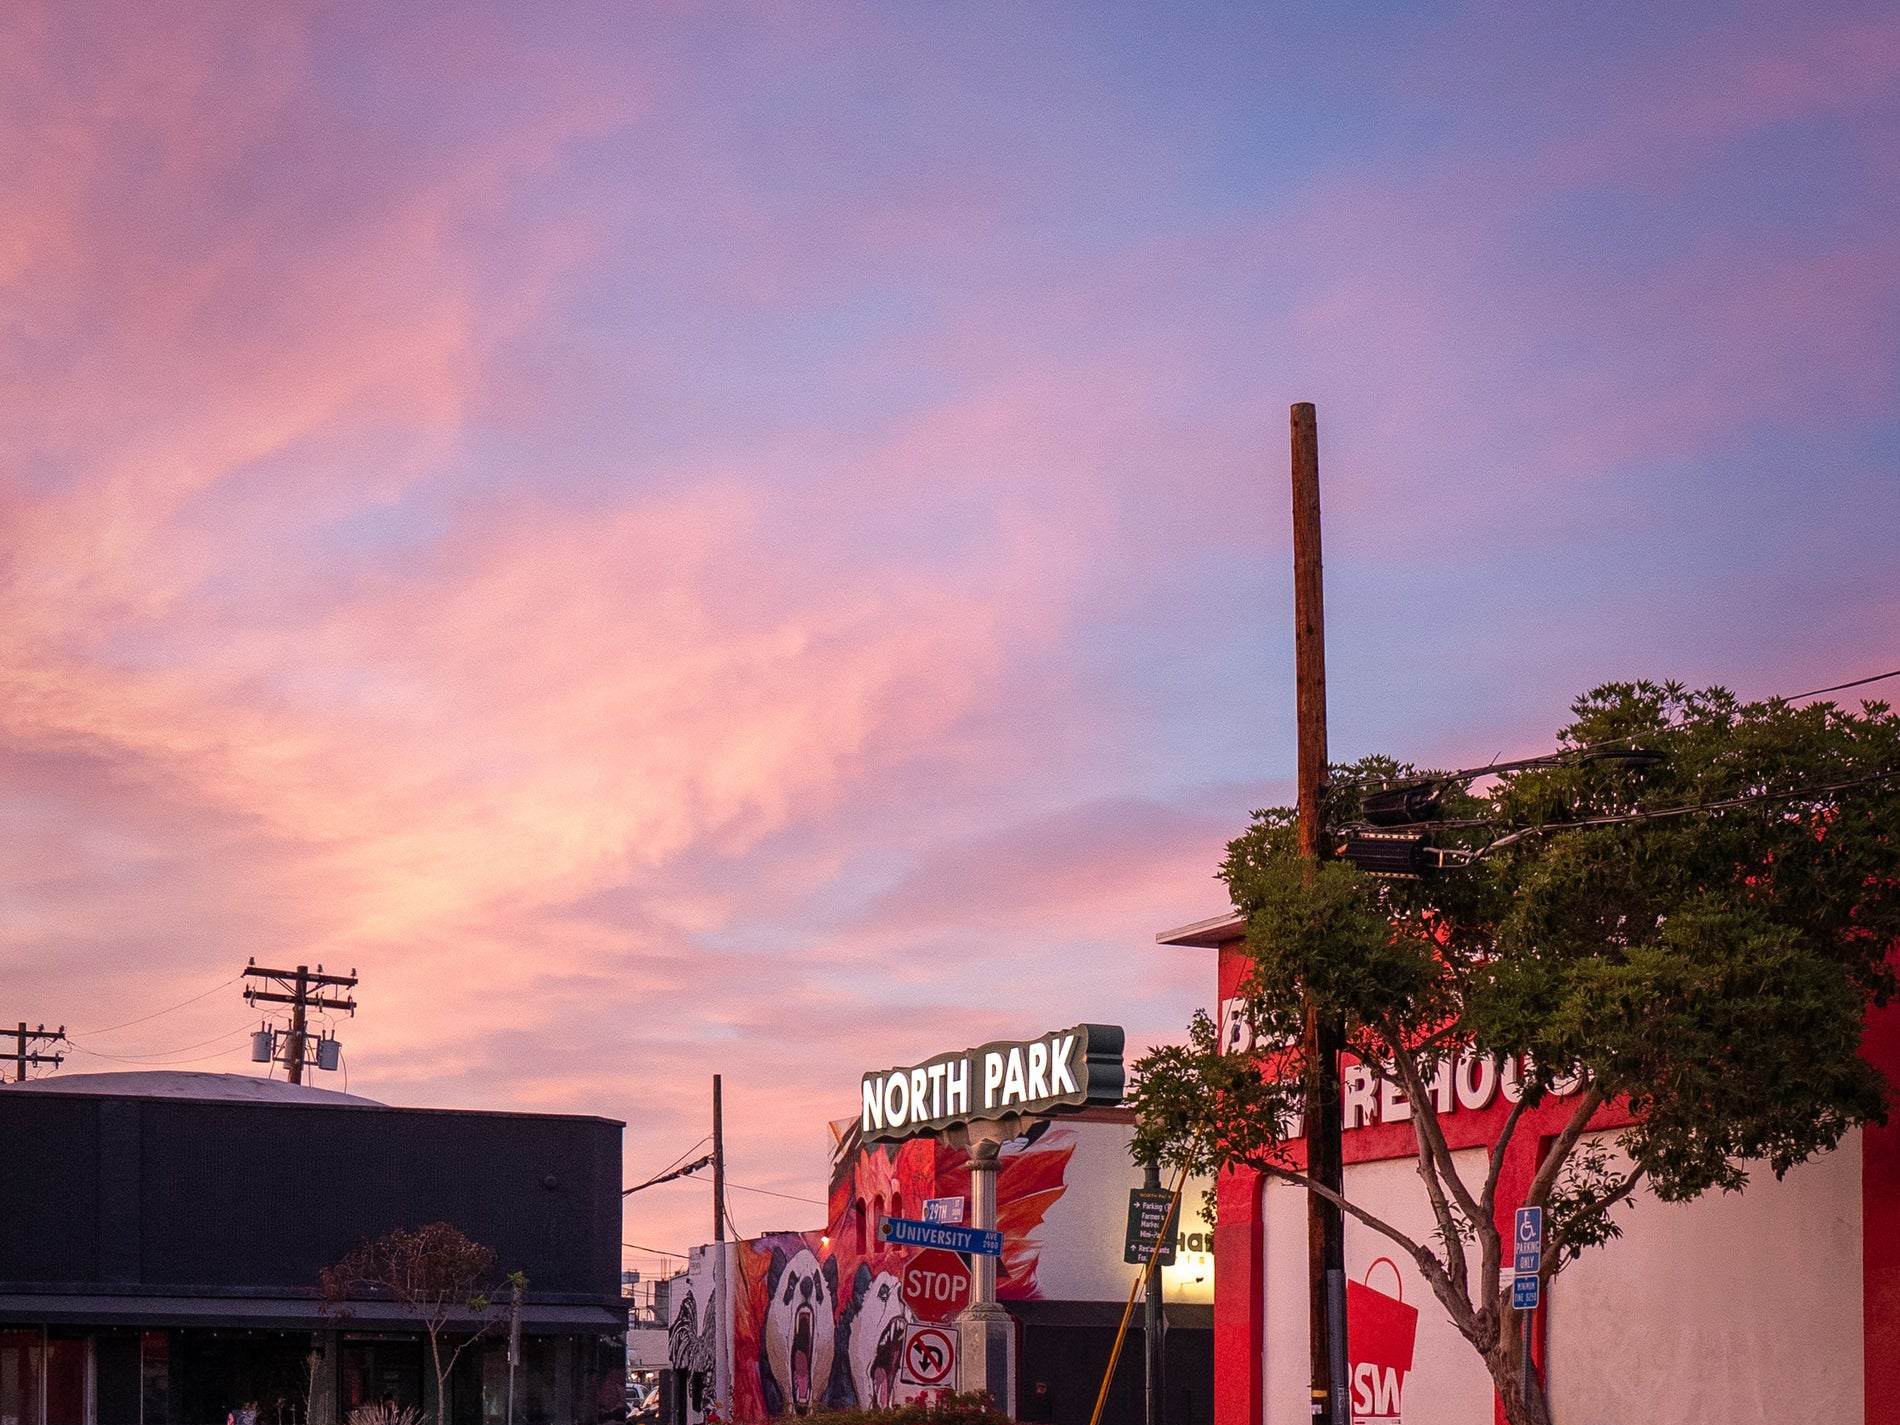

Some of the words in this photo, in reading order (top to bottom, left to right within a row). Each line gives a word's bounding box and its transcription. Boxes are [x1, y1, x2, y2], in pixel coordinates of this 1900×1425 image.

[862, 1057, 970, 1133] NORTH
[983, 1034, 1079, 1110] PARK
[929, 1204, 948, 1220] 29TH
[1142, 1202, 1163, 1212] Parking
[895, 1222, 972, 1248] UNIVERSITY
[985, 1232, 998, 1240] AVE
[1520, 1256, 1535, 1269] ONLY
[906, 1269, 967, 1302] STOP
[1348, 1362, 1401, 1415] SW
